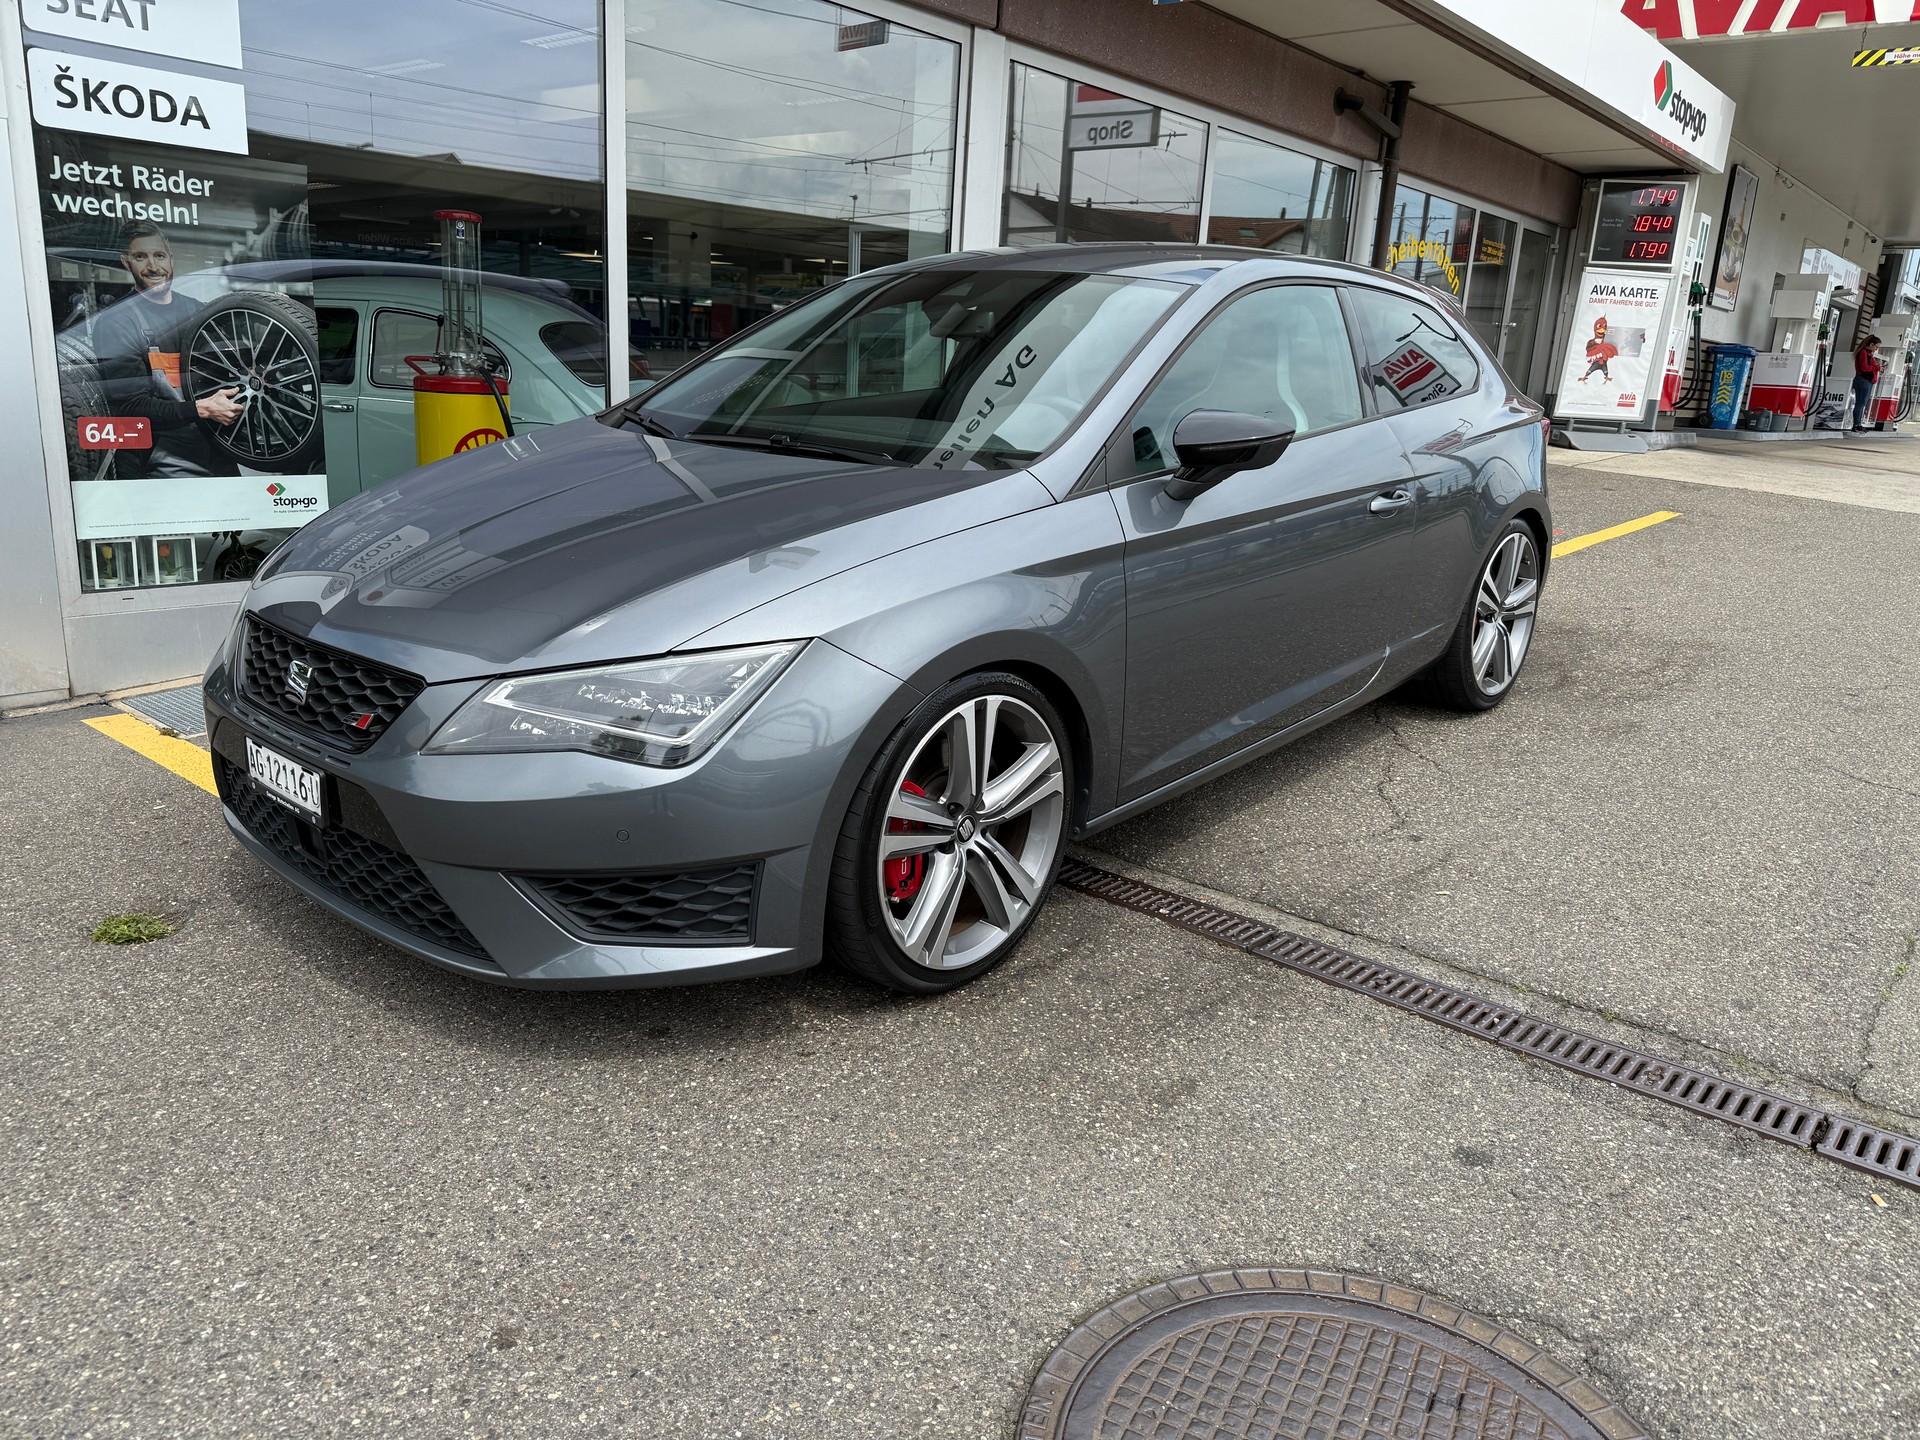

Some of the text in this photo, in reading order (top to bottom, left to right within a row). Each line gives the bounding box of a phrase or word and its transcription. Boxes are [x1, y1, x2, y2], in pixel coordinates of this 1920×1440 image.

[53, 64, 212, 130] ŠKODA
[1669, 90, 1707, 142] stop+go
[50, 155, 214, 197] Jetzt Räder
[52, 191, 199, 226] wechseln!
[1385, 233, 1460, 296] heibentönen
[1590, 284, 1659, 300] AVIA KARTE.
[1618, 391, 1636, 401] AVIA
[273, 496, 318, 509] stop+go
